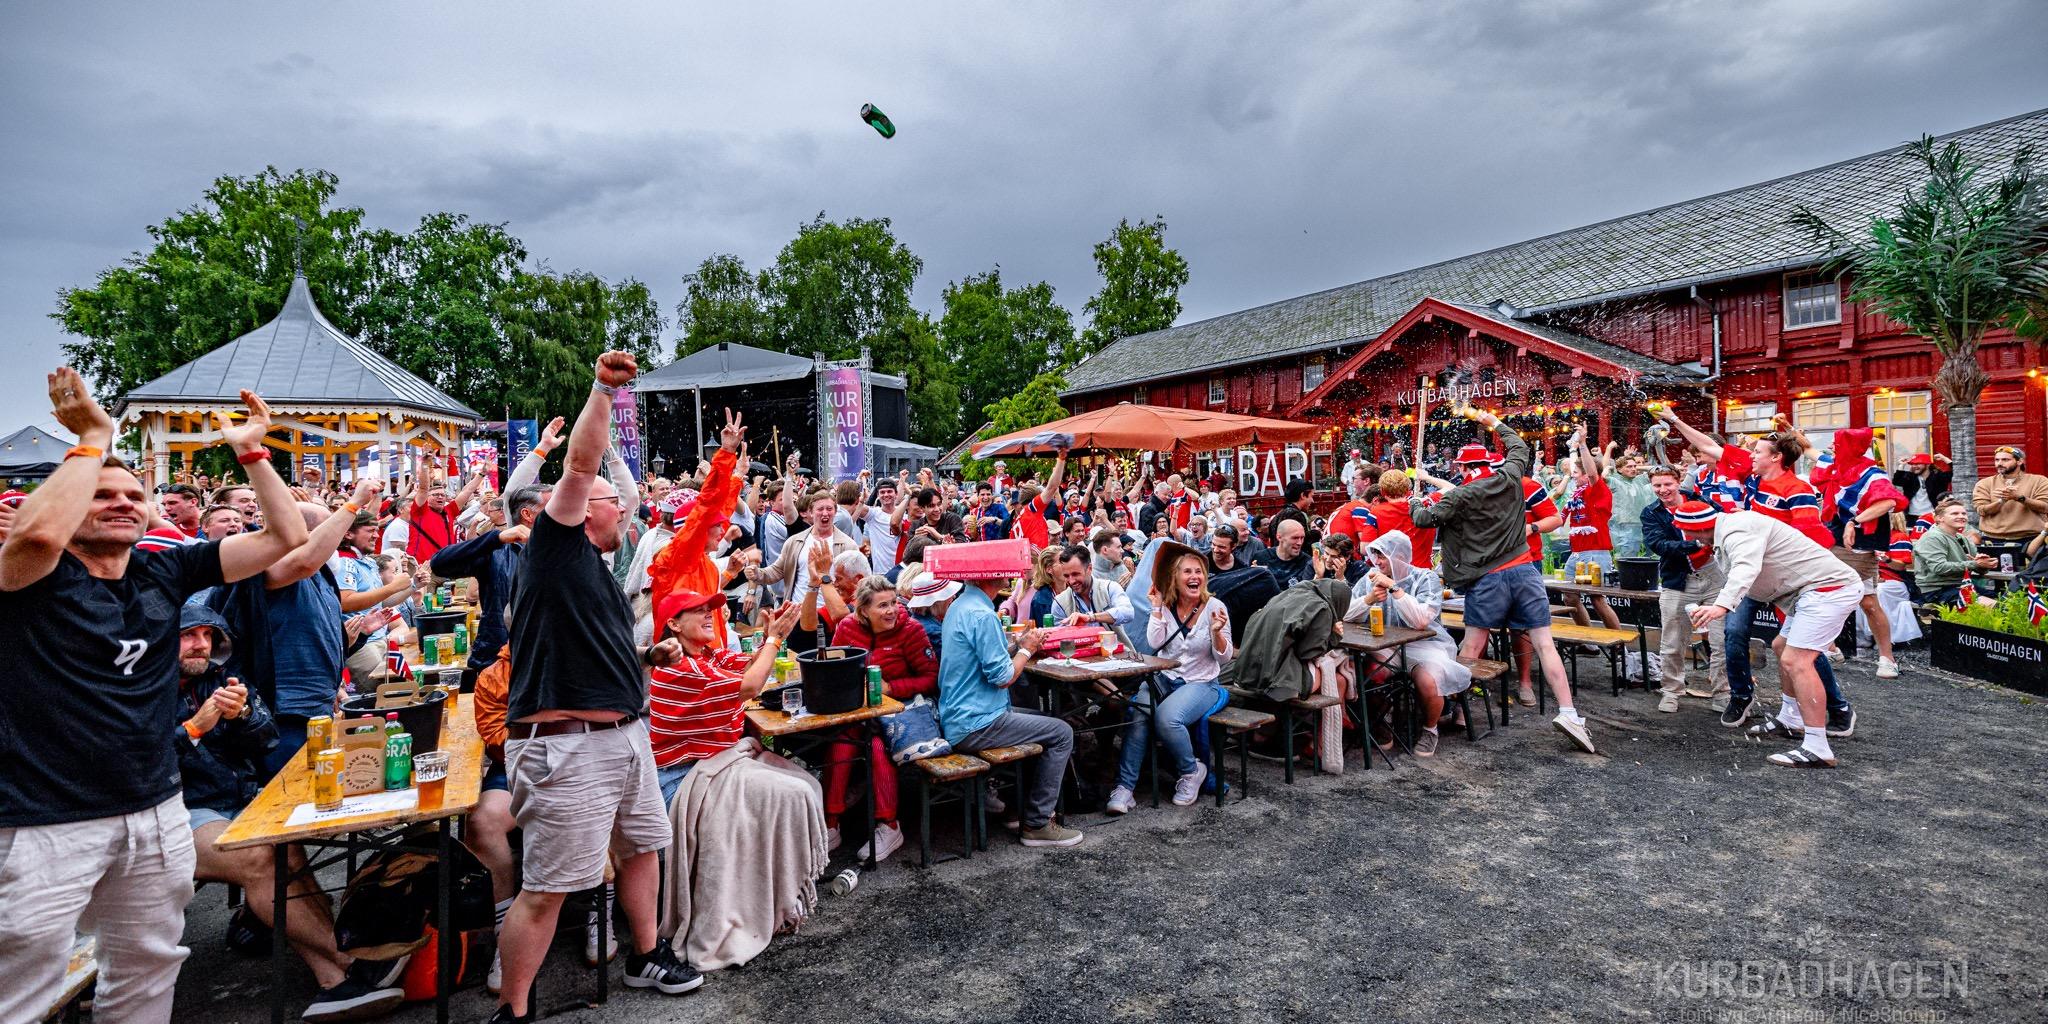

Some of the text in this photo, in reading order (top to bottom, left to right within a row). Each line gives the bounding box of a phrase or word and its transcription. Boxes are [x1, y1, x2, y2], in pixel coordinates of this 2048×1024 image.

[825, 391, 858, 408] KUR
[826, 411, 858, 428] BAD
[610, 426, 636, 442] BAD
[827, 431, 860, 448] HAG
[828, 451, 848, 468] EN
[1238, 447, 1308, 497] BAR
[1958, 632, 2042, 662] KURBADHAGEN
